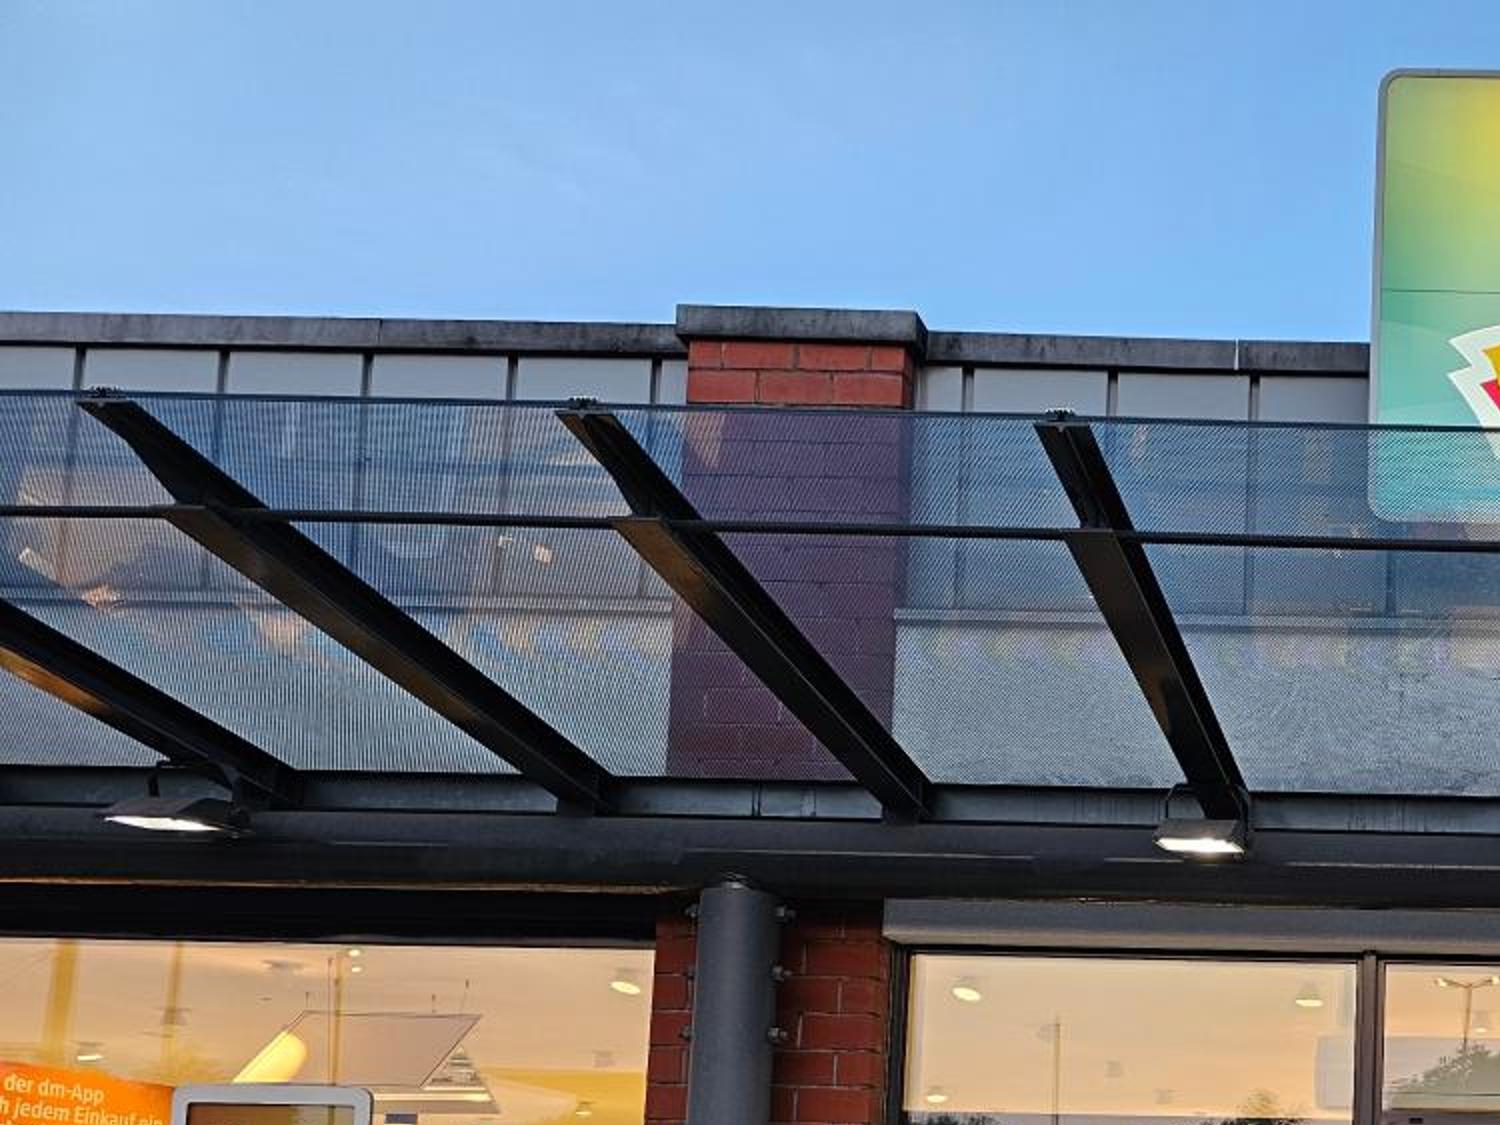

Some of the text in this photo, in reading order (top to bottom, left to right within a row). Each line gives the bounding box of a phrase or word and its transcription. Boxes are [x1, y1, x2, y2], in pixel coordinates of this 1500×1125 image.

[4, 1072, 105, 1107] der dm-App
[13, 1098, 70, 1121] jedem
